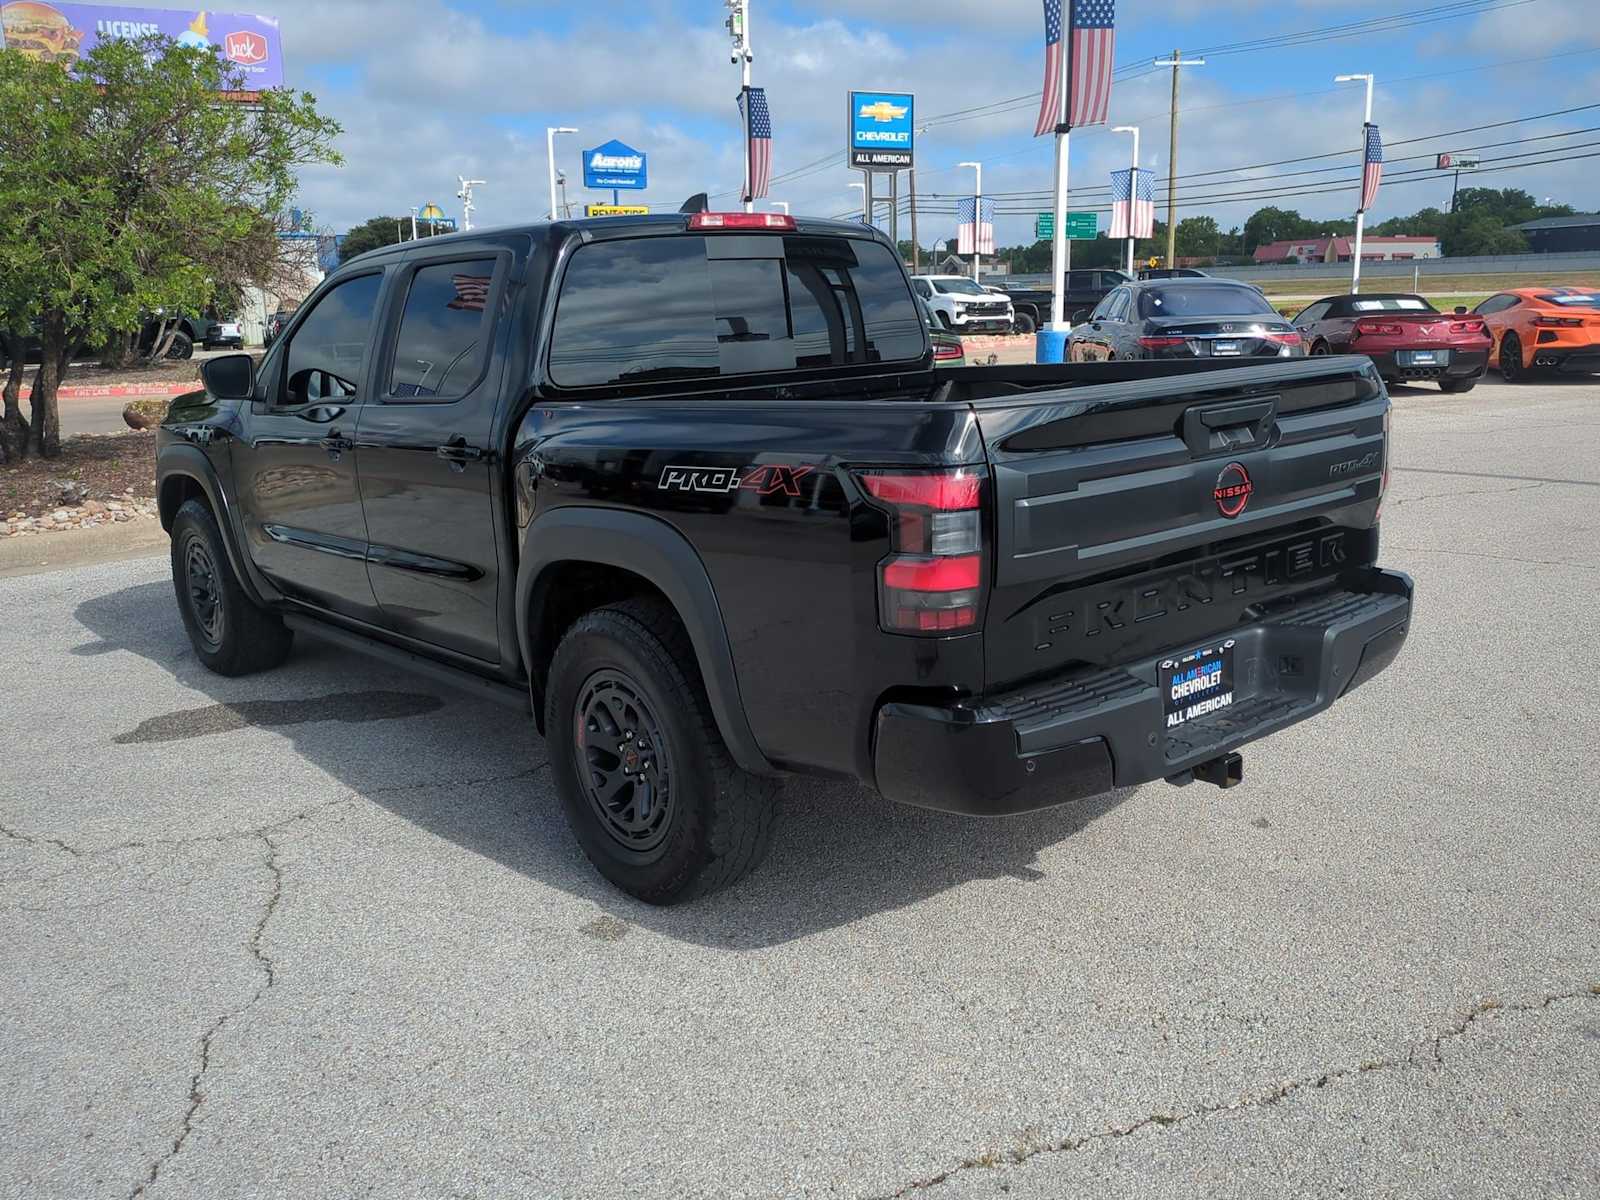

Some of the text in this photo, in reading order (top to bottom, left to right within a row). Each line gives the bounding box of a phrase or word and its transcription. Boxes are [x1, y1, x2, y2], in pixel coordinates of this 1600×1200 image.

[97, 20, 159, 38] LICENSE
[229, 35, 265, 59] Jack
[856, 131, 909, 142] CHEVROLET
[590, 152, 642, 169] Aaron's
[856, 153, 910, 163] ALL AMERICAN
[1213, 482, 1253, 500] NISSAN
[1033, 532, 1348, 650] FRONTIER
[1172, 660, 1222, 686] ALL AMERICAN
[1171, 670, 1222, 700] CHEVROLET
[1167, 691, 1233, 728] ALL AMERICAN
